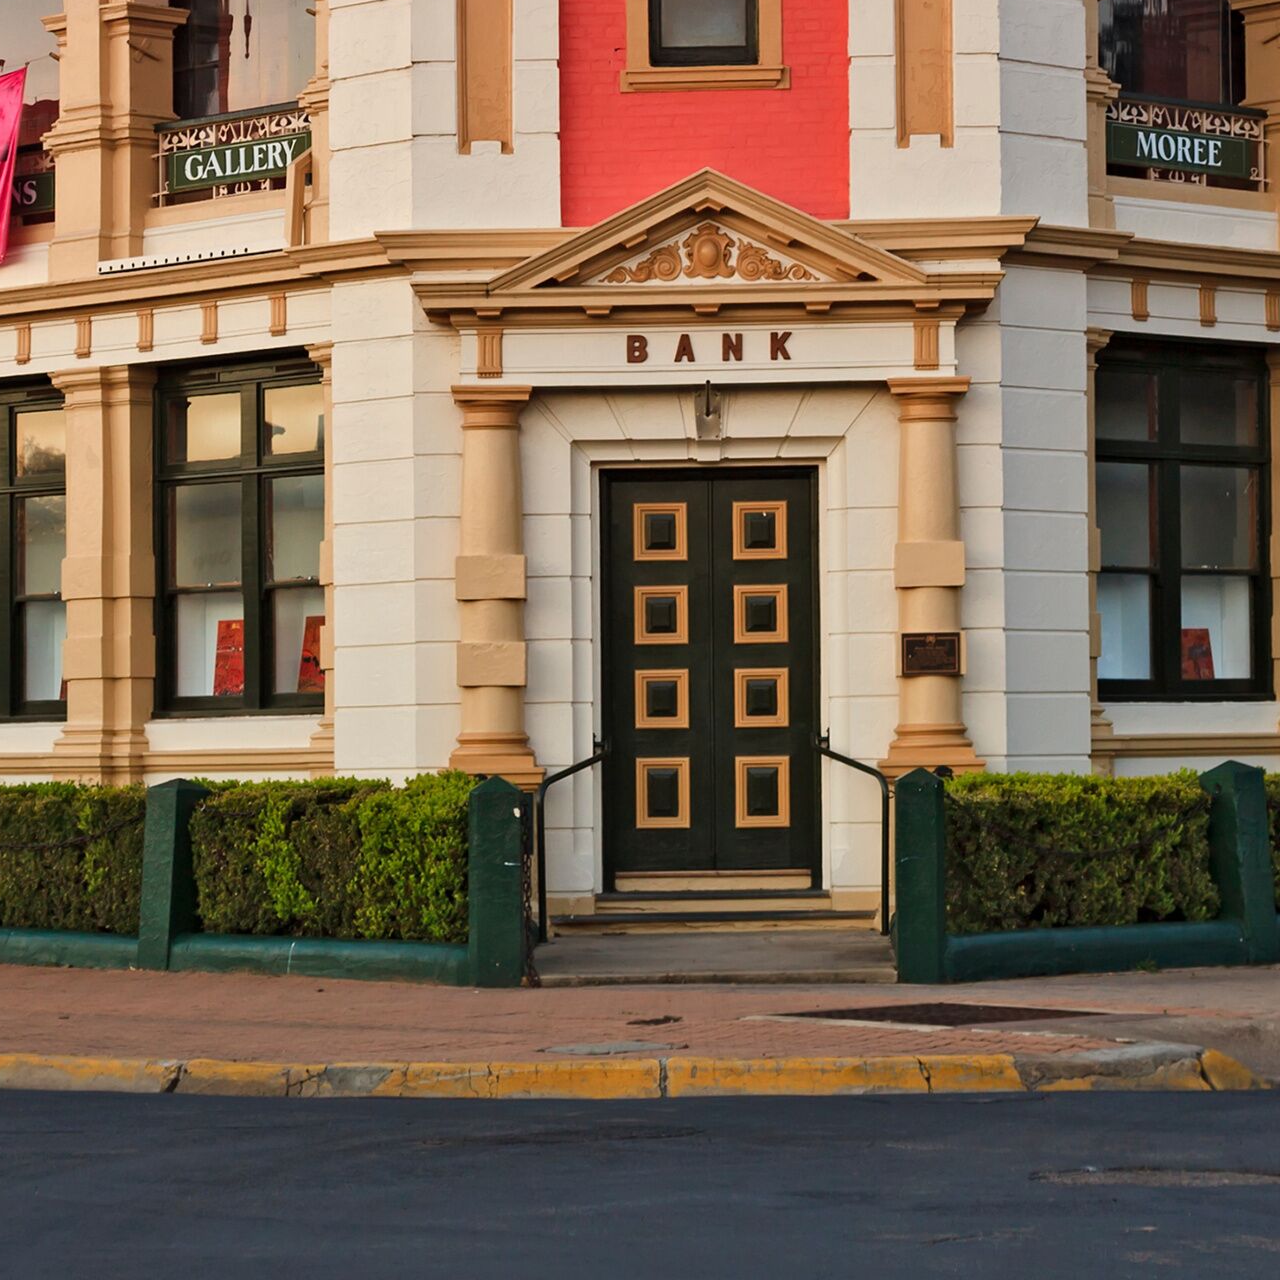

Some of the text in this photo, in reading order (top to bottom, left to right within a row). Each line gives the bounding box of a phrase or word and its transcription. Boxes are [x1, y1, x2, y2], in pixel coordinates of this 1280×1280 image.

[184, 139, 297, 182] GALLERY
[1136, 131, 1223, 167] MOREE
[626, 331, 793, 364] BANK
